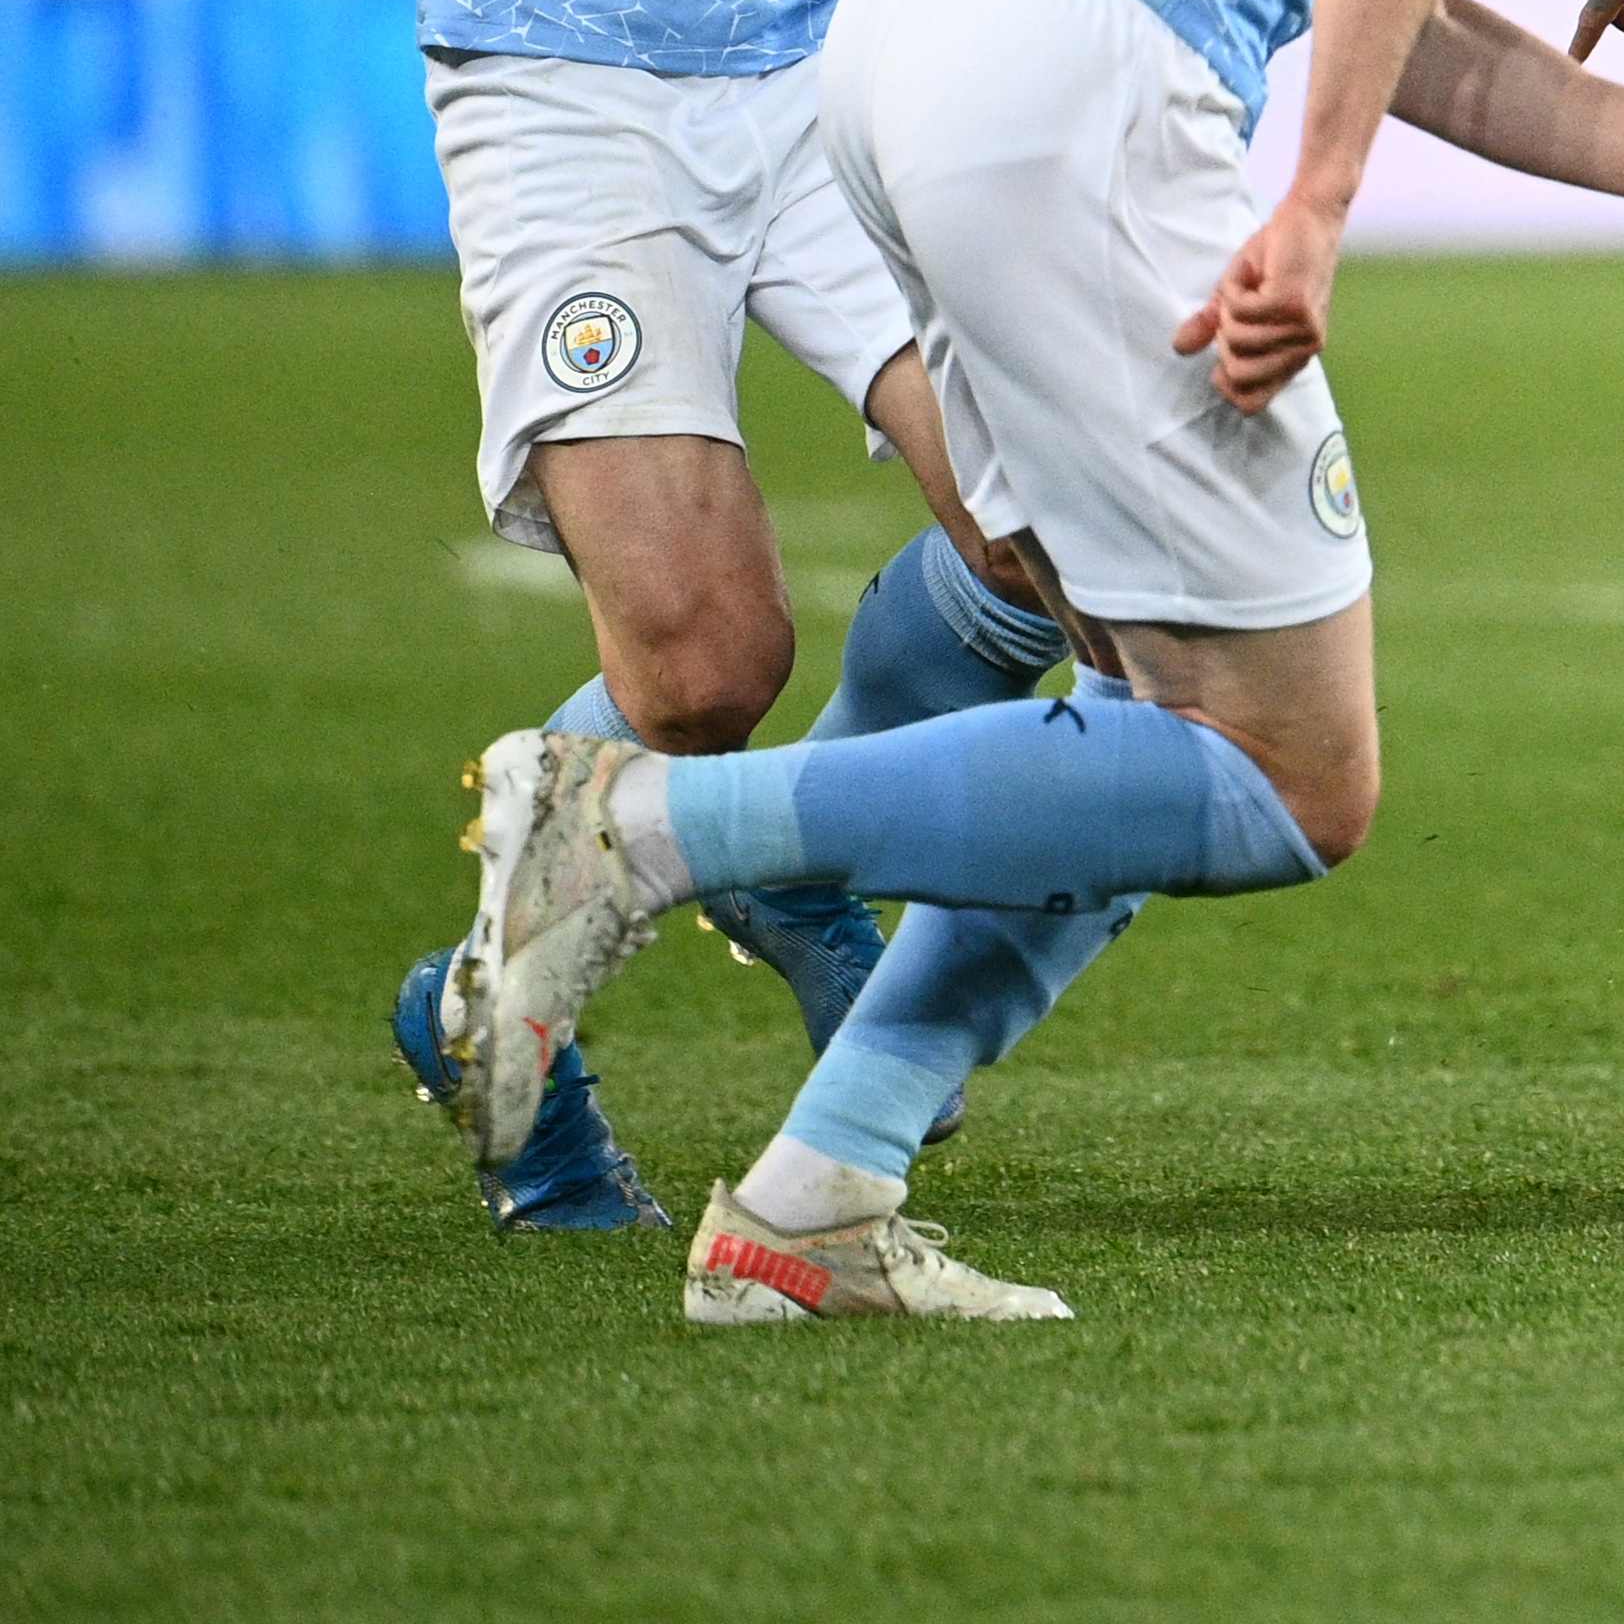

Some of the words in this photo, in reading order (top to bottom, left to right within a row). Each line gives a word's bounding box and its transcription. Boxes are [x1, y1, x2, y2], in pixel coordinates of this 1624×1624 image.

[551, 300, 627, 340] MANCHESTER
[582, 372, 610, 386] CITY
[705, 1232, 833, 1308] PUMA
